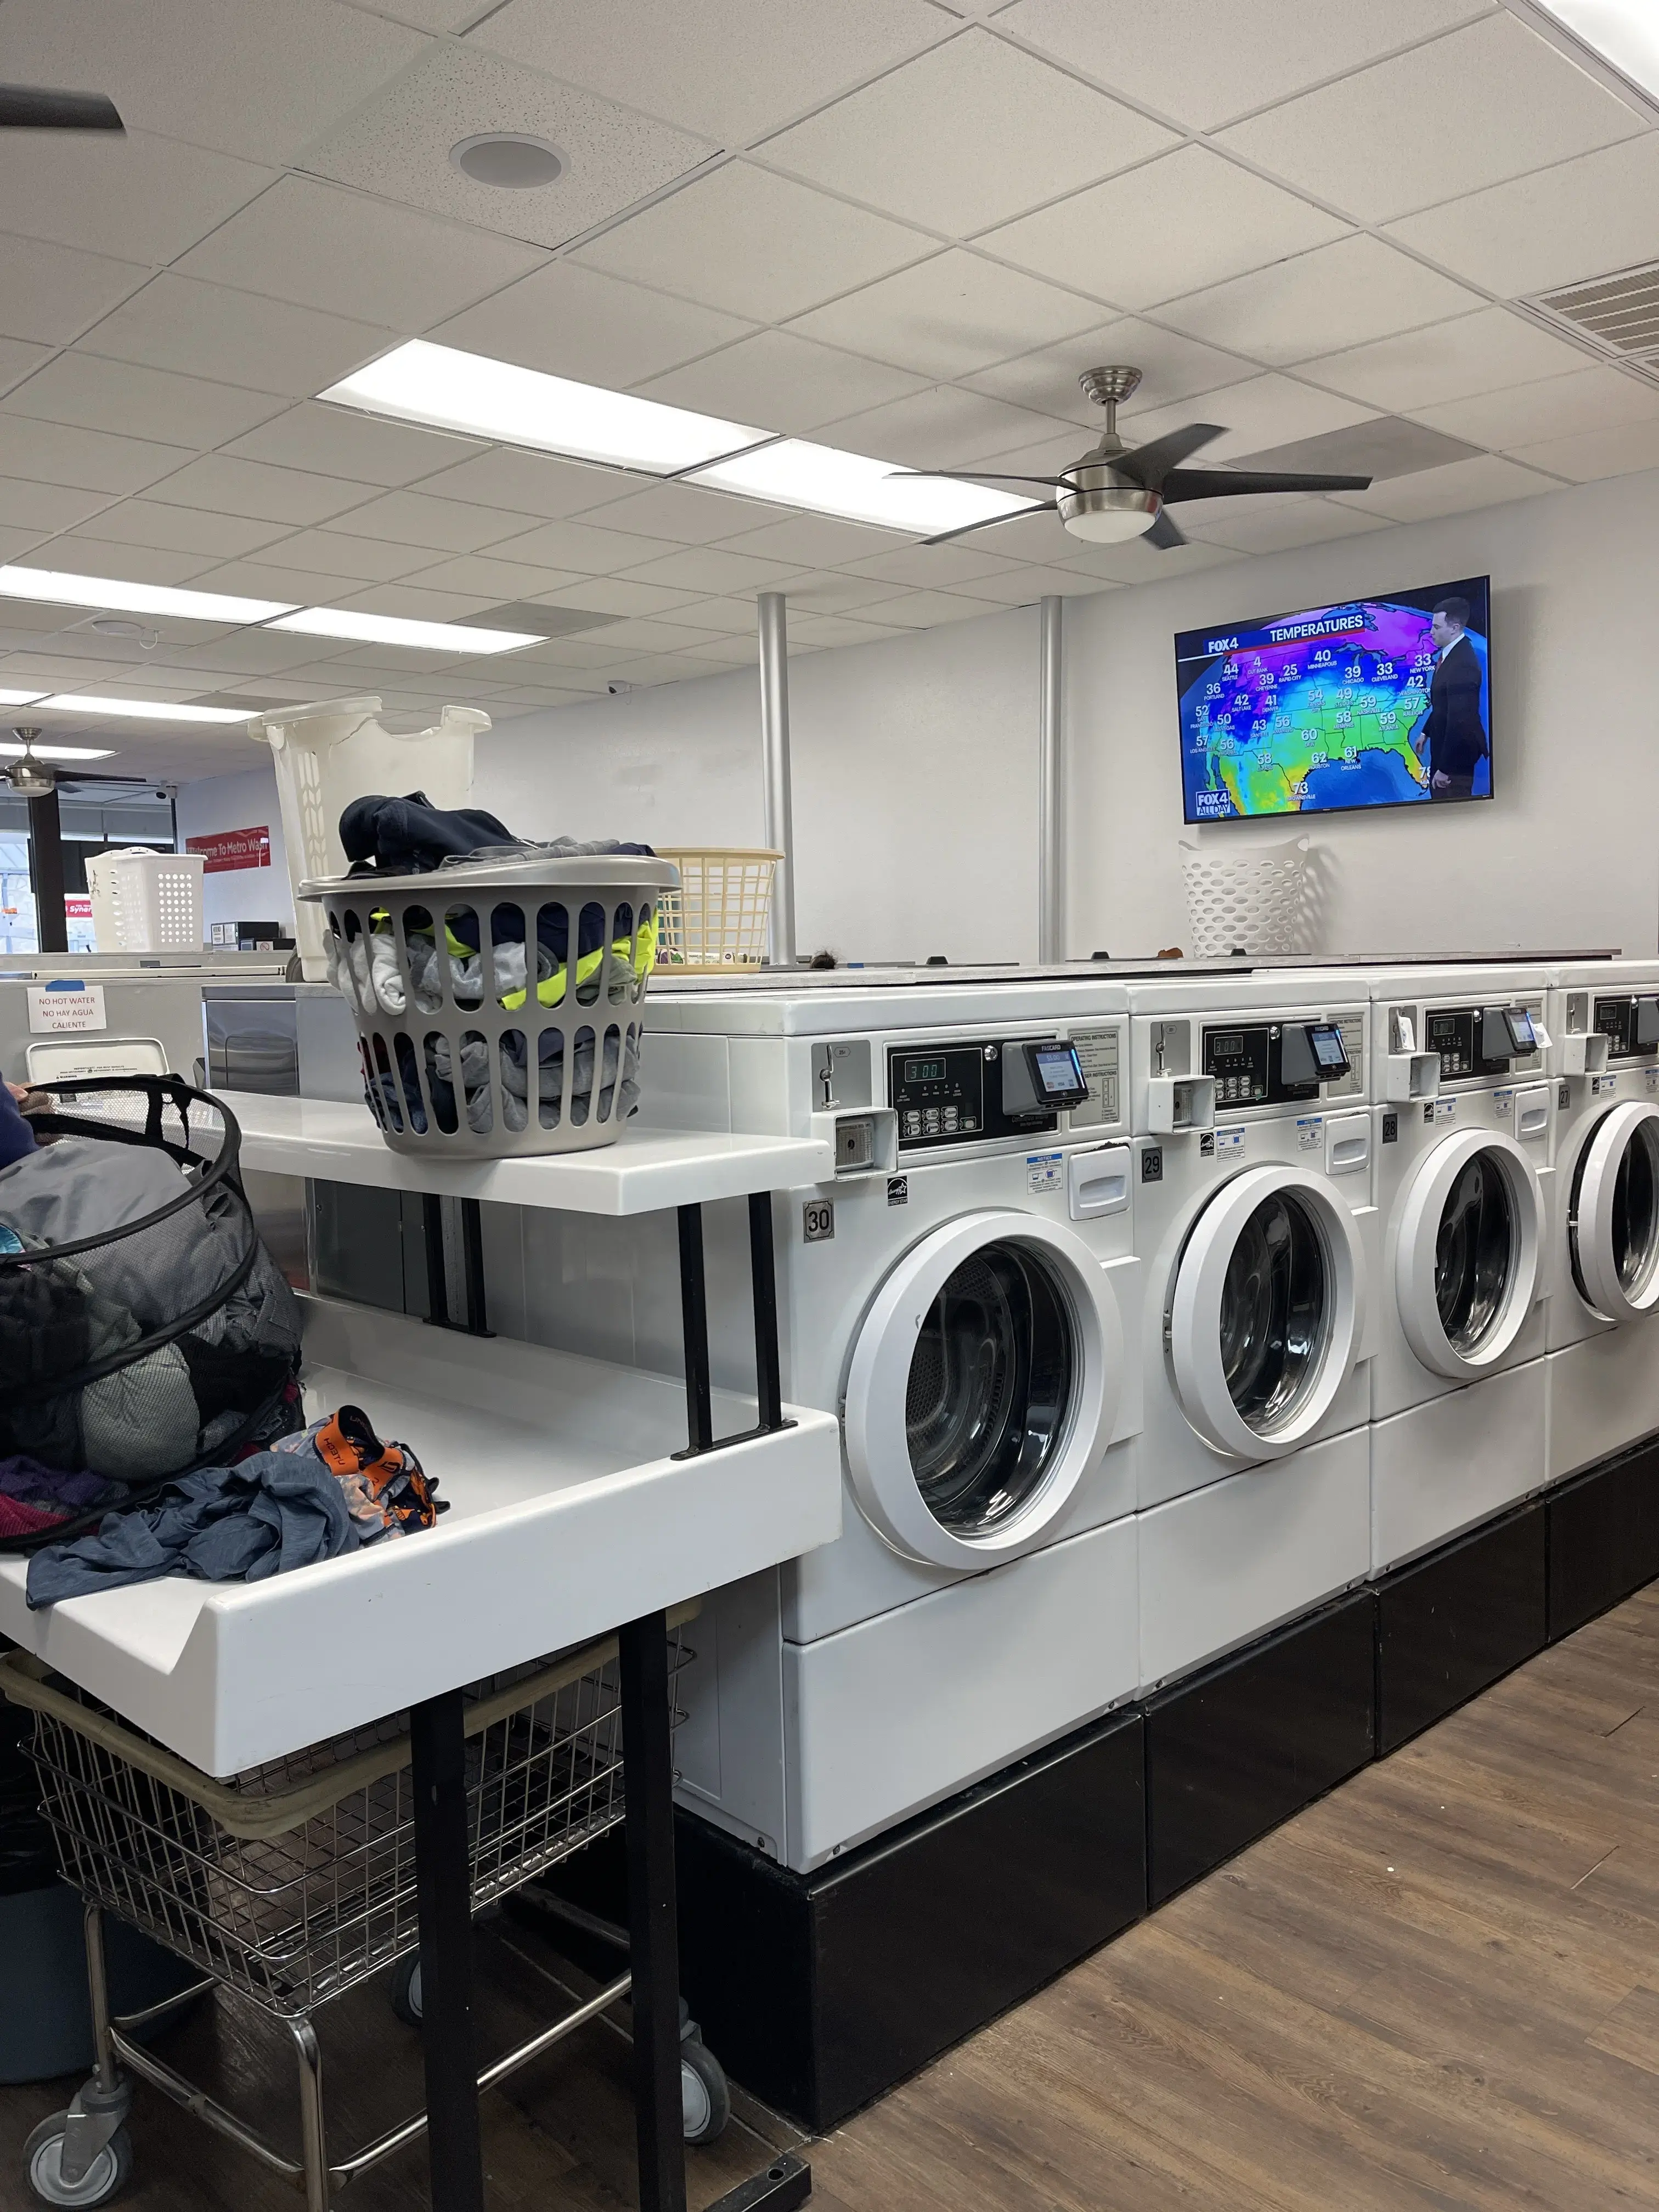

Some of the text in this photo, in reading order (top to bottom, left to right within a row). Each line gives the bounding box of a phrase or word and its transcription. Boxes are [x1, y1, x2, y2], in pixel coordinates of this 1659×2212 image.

[1270, 615, 1363, 641] TEMPERATURES
[1254, 656, 1261, 667] 4
[1314, 650, 1331, 662] 40
[1414, 653, 1431, 667] 33
[1223, 663, 1239, 675] 44
[1283, 664, 1297, 676] 25
[1345, 665, 1361, 679] 39
[1376, 662, 1393, 675] 33
[1259, 673, 1274, 685] 39
[1372, 674, 1398, 682] CLEVELAND
[1407, 675, 1424, 688] 42
[1206, 682, 1221, 695] 36
[1255, 684, 1278, 692] CHEYENNE
[1336, 688, 1352, 700] 49
[1234, 694, 1249, 706] 42
[1265, 695, 1277, 706] 41
[1308, 689, 1324, 702] 54
[1360, 695, 1376, 708] 59
[1404, 697, 1420, 710] 57
[1195, 706, 1209, 717] 52
[1336, 710, 1352, 724] 58
[1217, 713, 1231, 725] 50
[1276, 716, 1290, 728] 56
[1380, 712, 1396, 724] 59
[1252, 719, 1267, 731] 43
[1196, 735, 1209, 746] 57
[1301, 729, 1318, 741] 60
[1220, 739, 1234, 750] 56
[1312, 751, 1328, 764] 62
[1345, 746, 1357, 758] 61
[1257, 753, 1272, 765] 58
[1293, 781, 1308, 794] 73
[1199, 804, 1228, 815] ALL DAY
[218, 843, 226, 856] To
[227, 841, 246, 854] Metro
[1560, 1091, 1568, 1104] 27
[1385, 1121, 1395, 1136] 28
[1145, 1156, 1159, 1174] 29
[808, 1209, 829, 1232] 30
